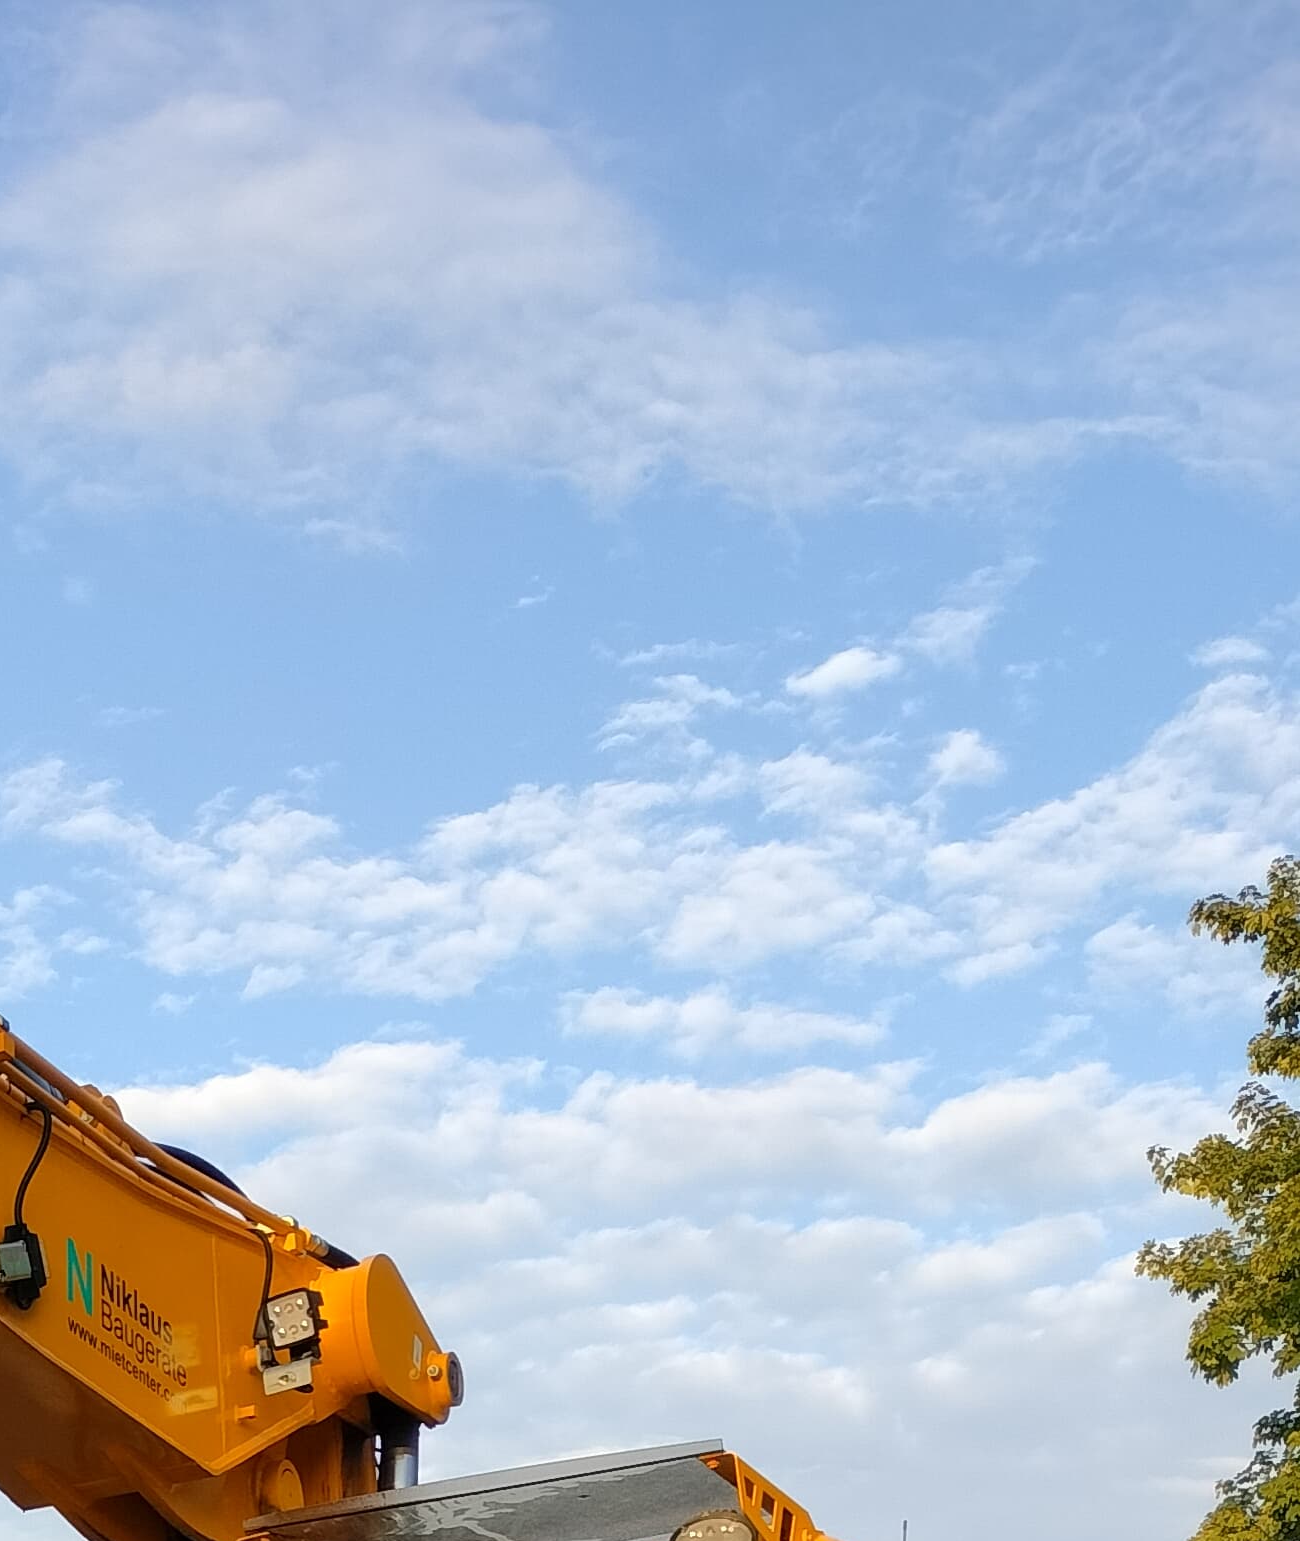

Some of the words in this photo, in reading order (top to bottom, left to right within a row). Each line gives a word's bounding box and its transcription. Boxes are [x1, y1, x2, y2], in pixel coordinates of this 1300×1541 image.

[66, 1237, 93, 1317] N
[100, 1263, 173, 1346] Niklaus
[67, 1316, 182, 1411] www.mietcenter.c
